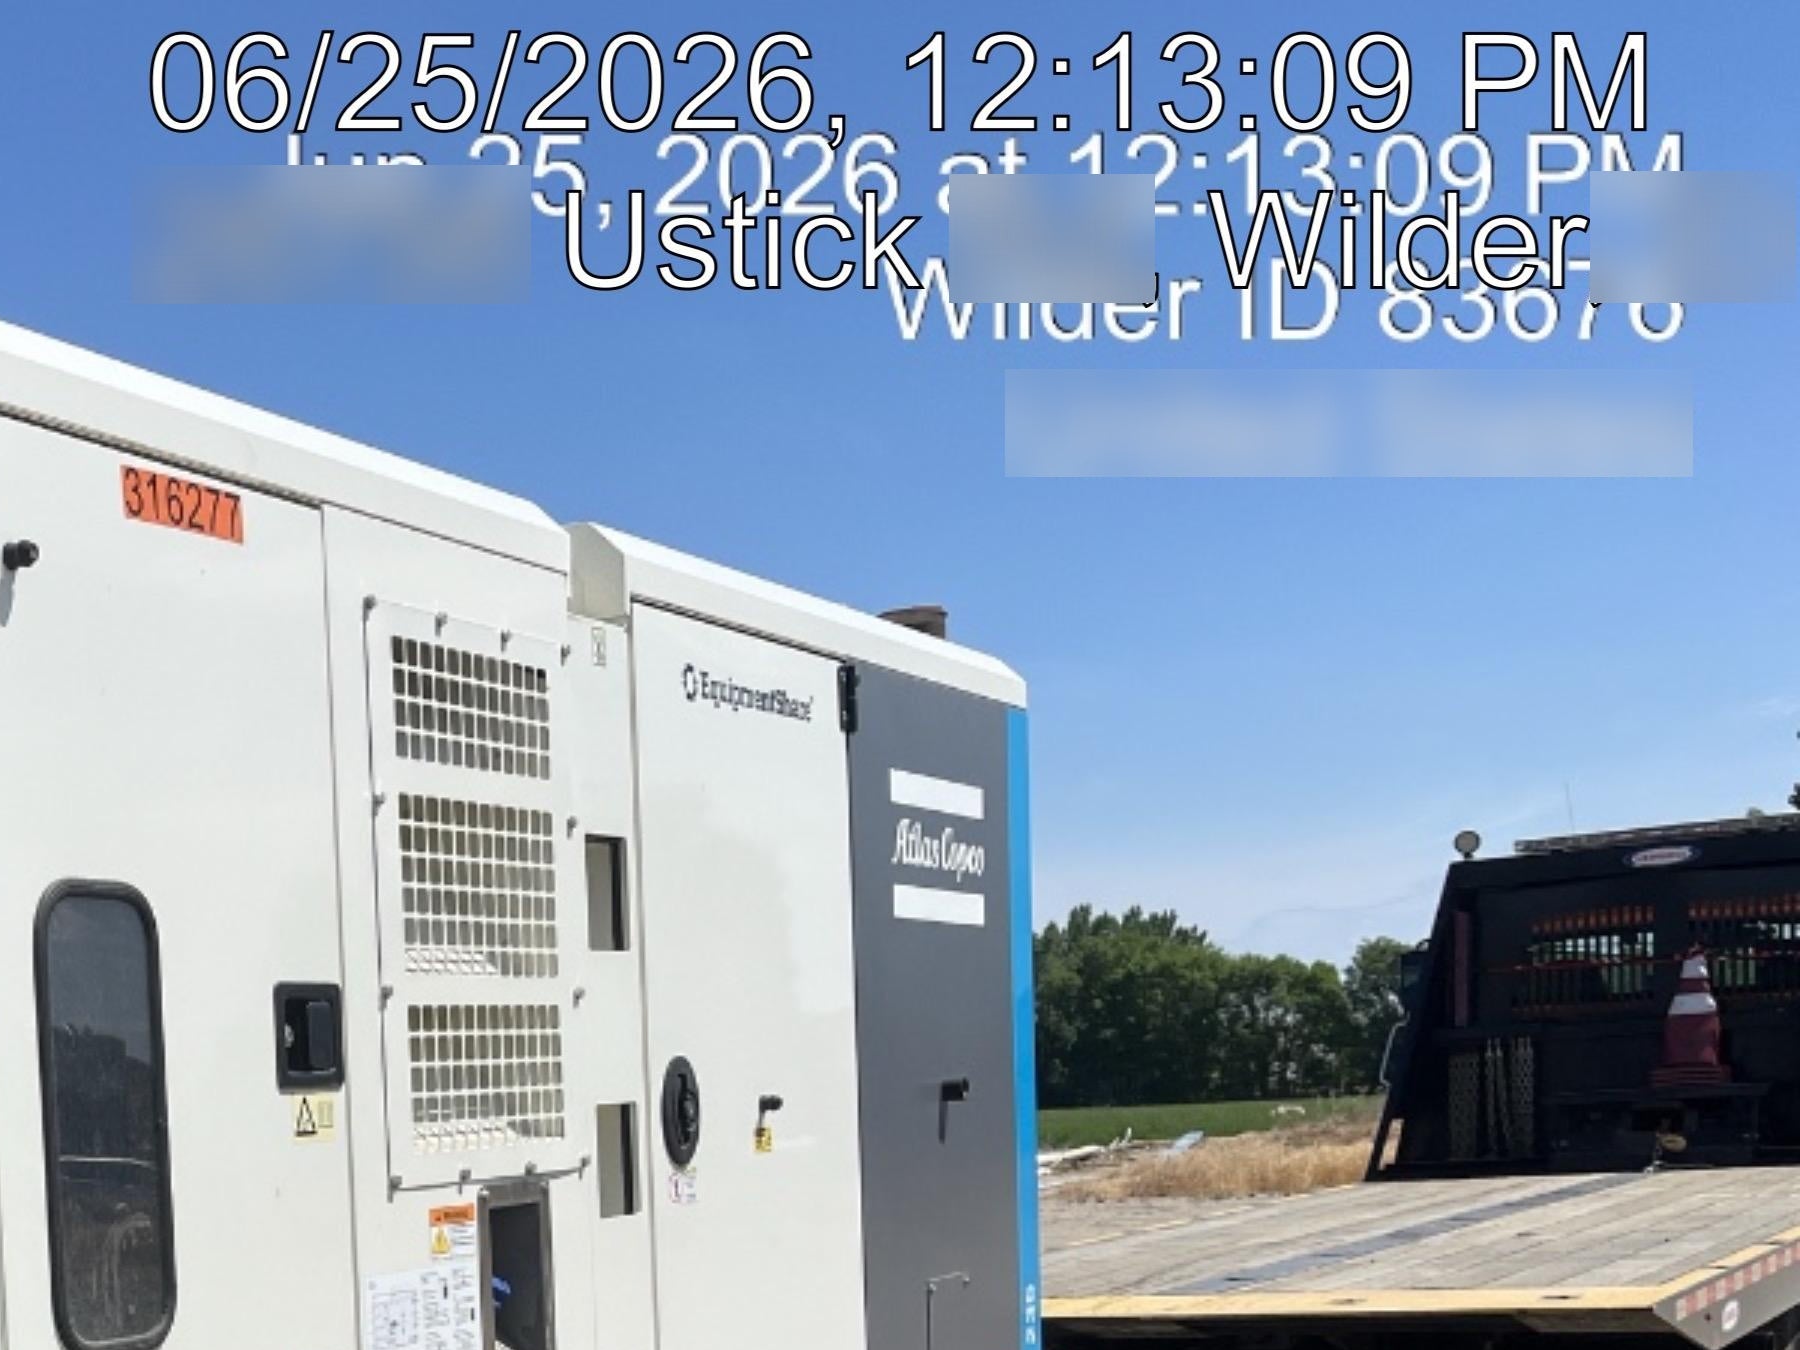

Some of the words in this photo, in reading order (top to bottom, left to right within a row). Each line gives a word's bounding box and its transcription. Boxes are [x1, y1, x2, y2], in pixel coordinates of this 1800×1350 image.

[125, 467, 241, 538] 316277
[889, 818, 940, 869] Atlas
[941, 826, 985, 883] Copco
